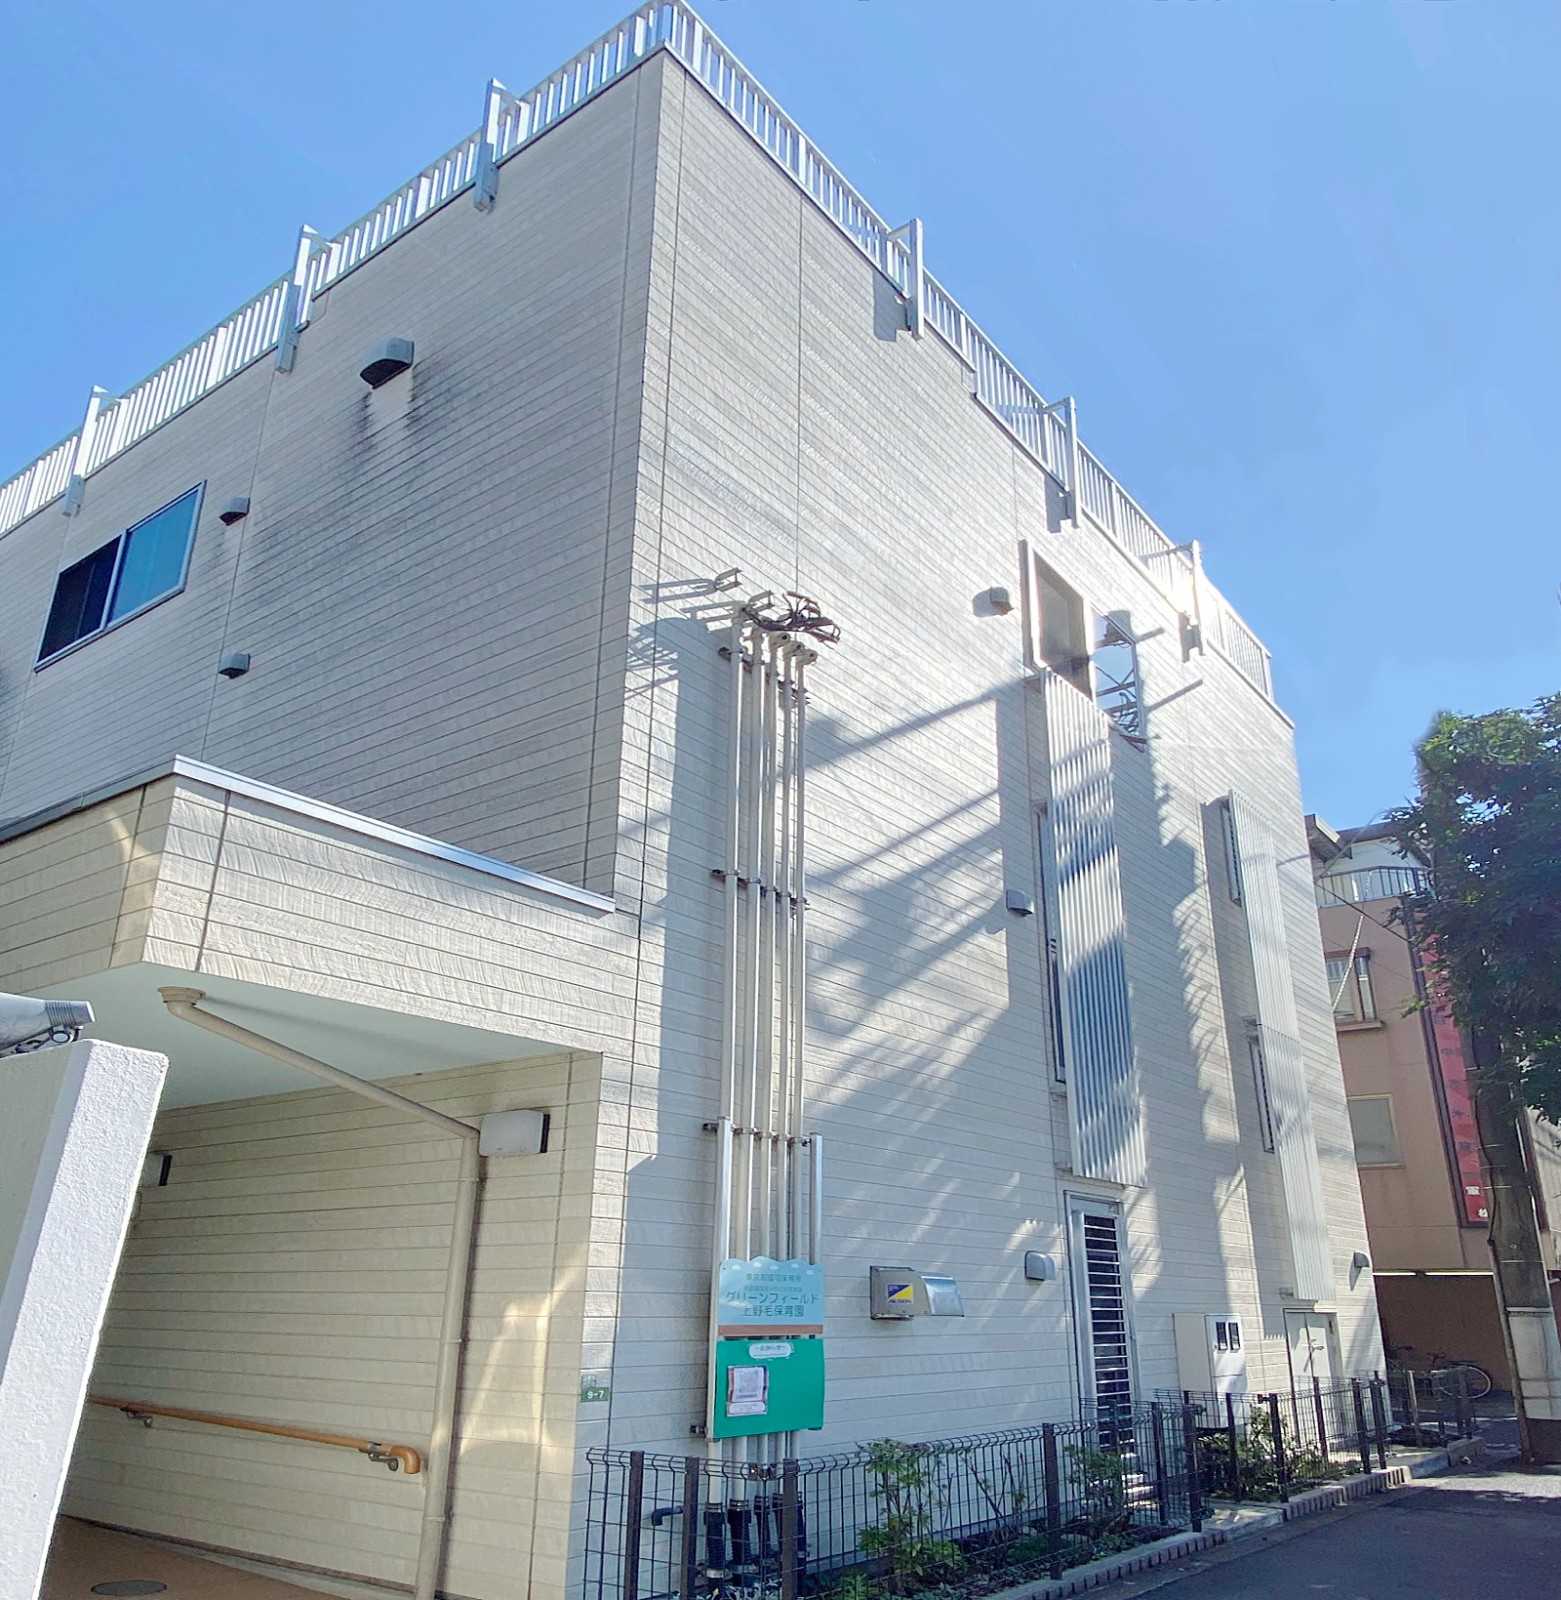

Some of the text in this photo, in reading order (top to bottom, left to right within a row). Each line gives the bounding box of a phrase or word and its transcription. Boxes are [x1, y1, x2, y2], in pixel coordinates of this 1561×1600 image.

[725, 1291, 819, 1304] グリーンフィールド
[744, 1305, 805, 1317] 上野毛保育園
